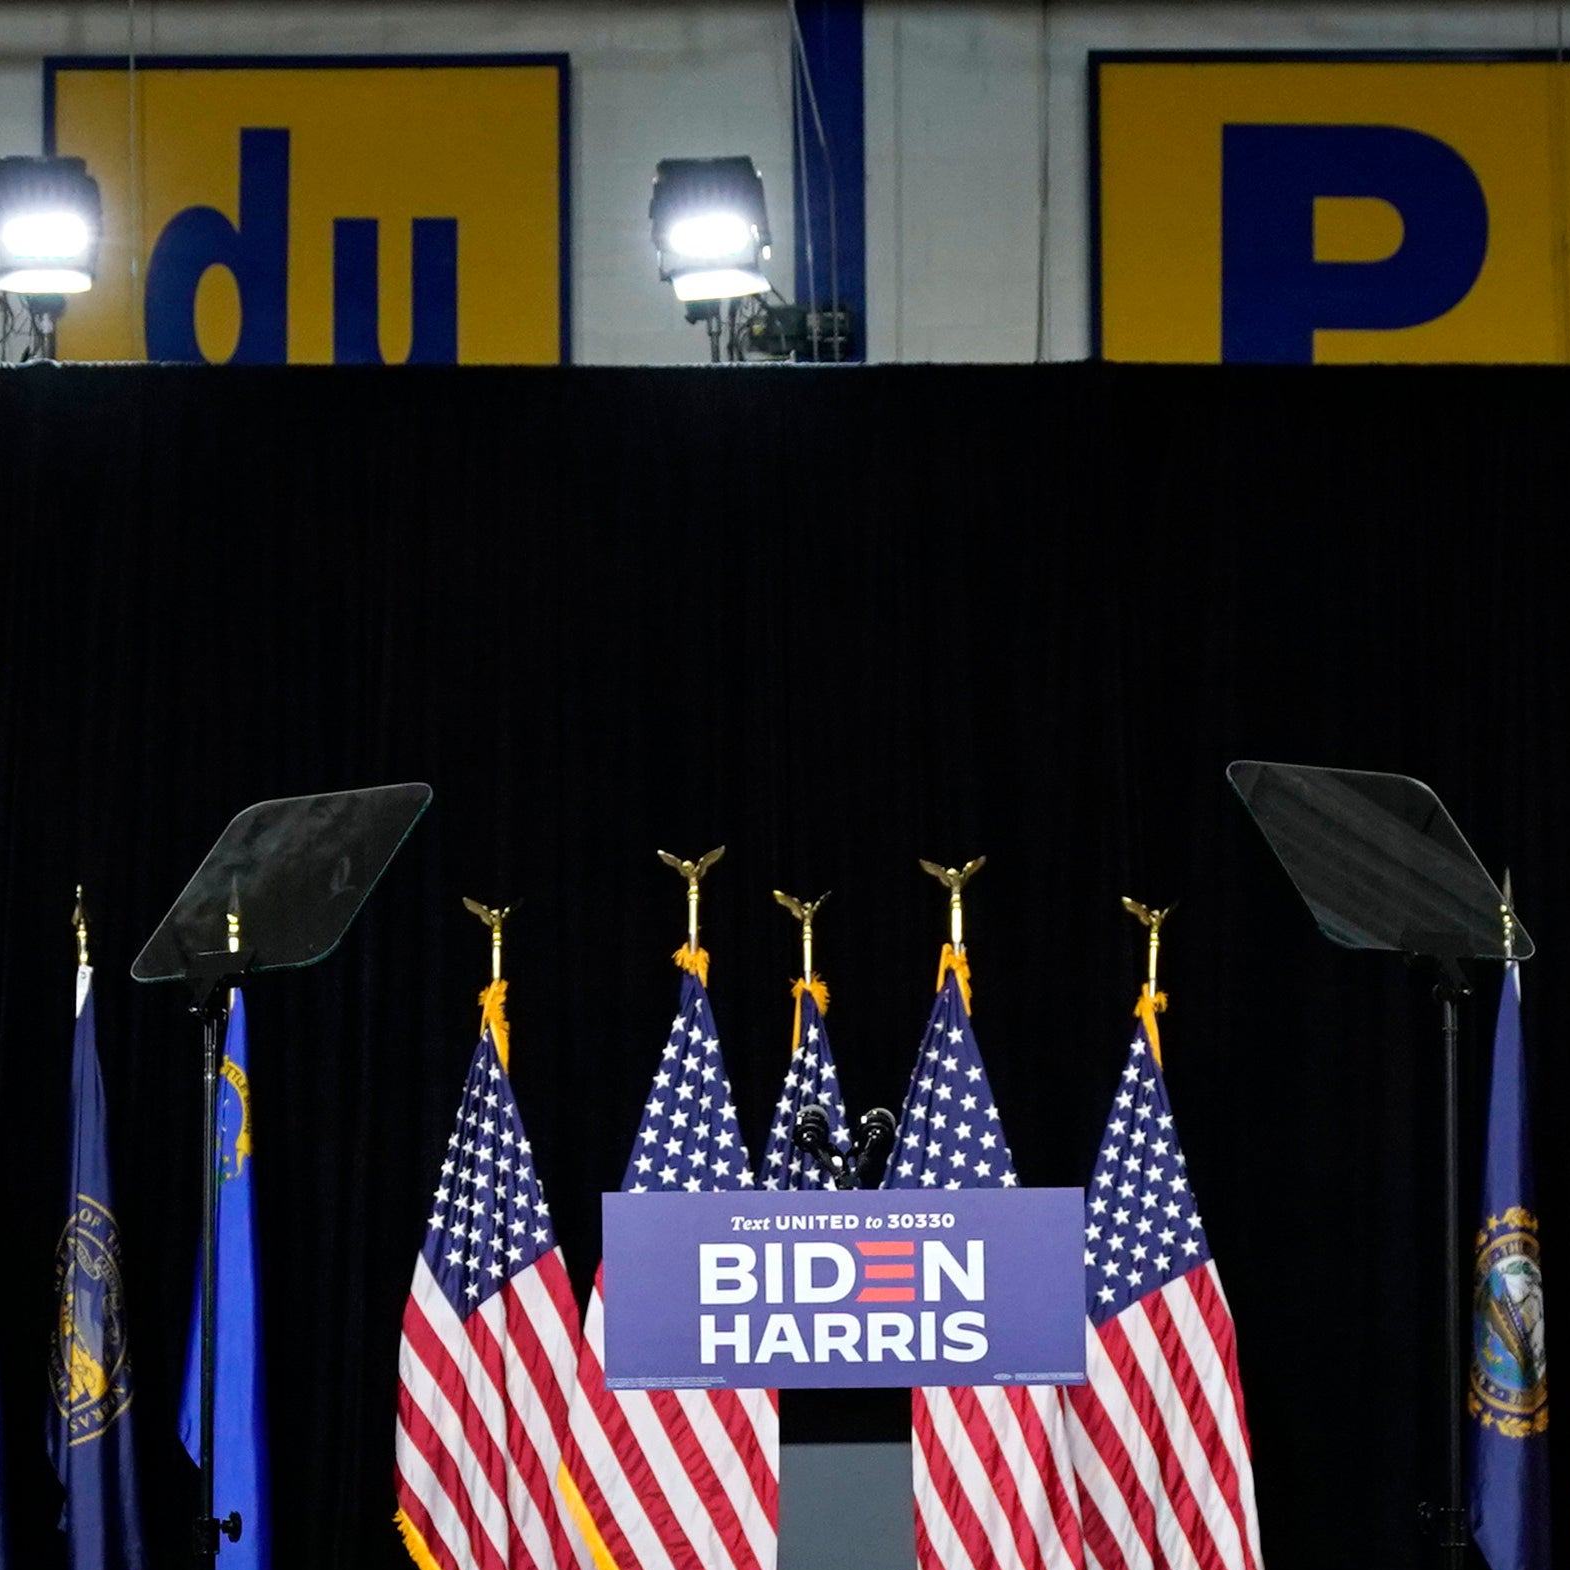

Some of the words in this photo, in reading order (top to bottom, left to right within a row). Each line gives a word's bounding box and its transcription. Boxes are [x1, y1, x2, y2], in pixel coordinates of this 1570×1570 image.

[145, 127, 458, 364] du
[731, 1216, 771, 1231] Text
[775, 1214, 859, 1230] UNITED
[865, 1214, 883, 1230] to
[887, 1213, 956, 1229] 30330
[698, 1239, 985, 1305] BIDEN
[699, 1310, 989, 1364] HARRIS
